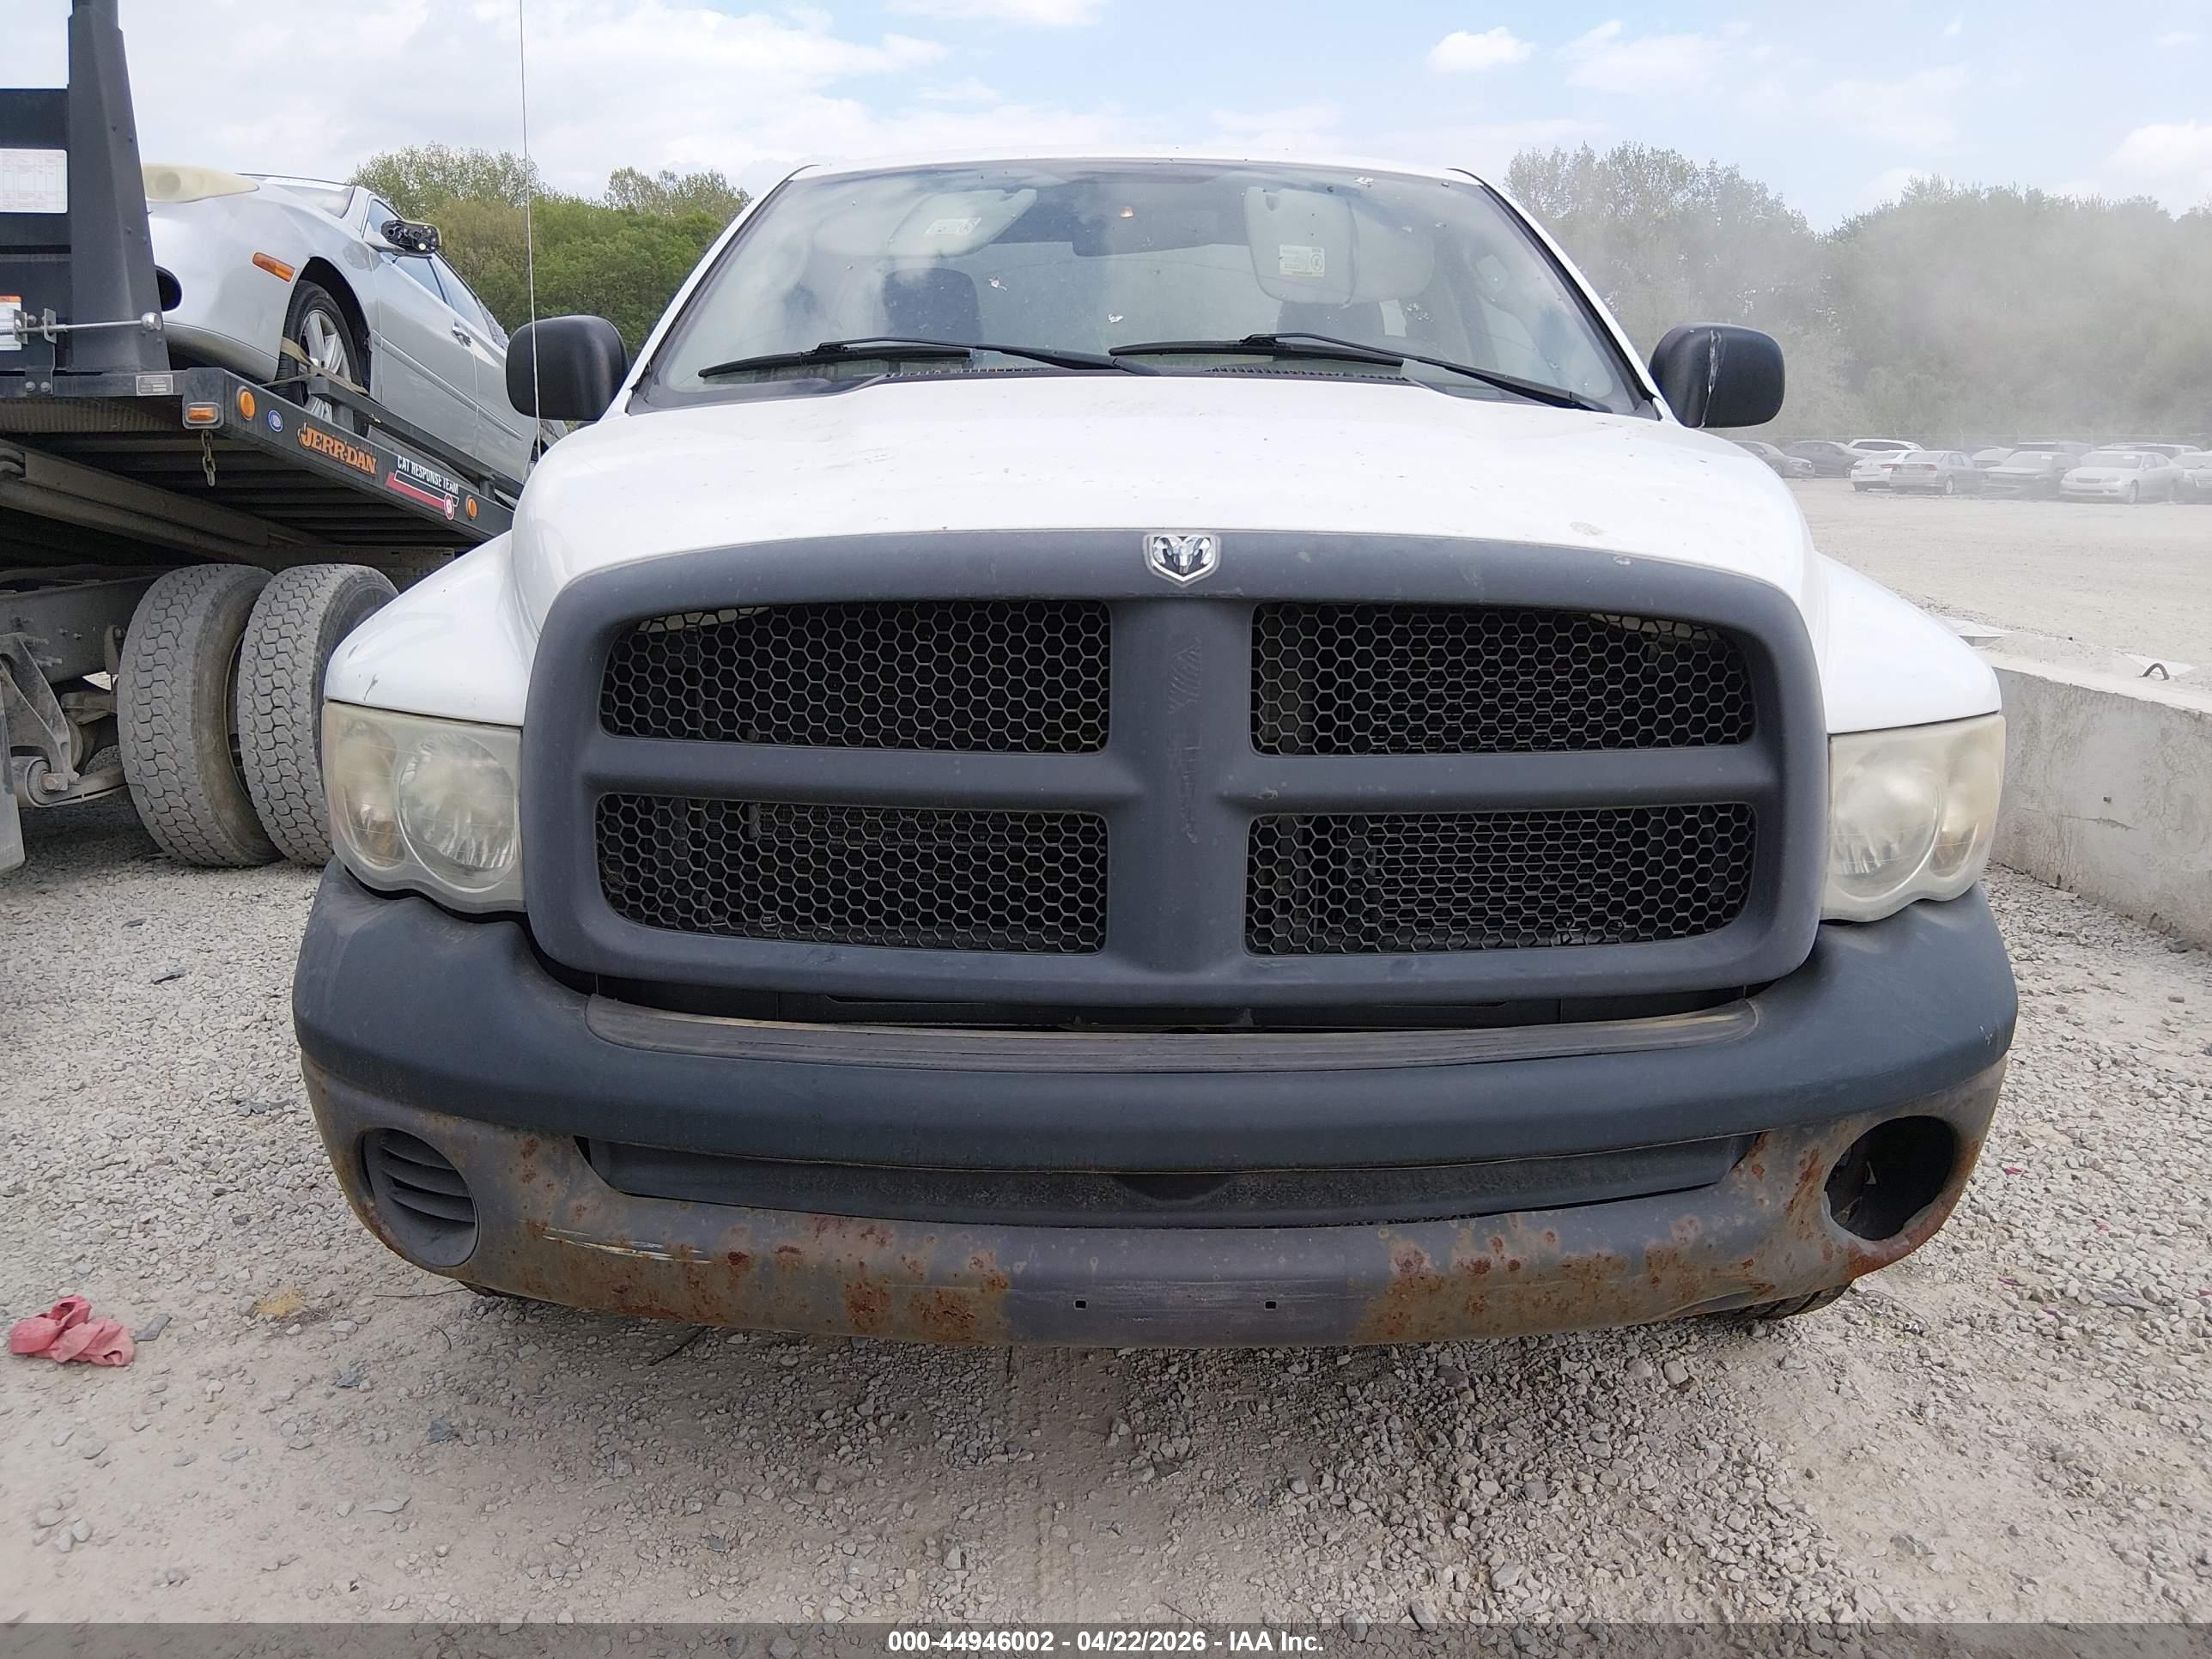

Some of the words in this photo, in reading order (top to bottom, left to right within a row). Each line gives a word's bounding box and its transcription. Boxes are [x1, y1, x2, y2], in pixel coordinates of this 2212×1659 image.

[398, 455, 410, 472] CAT
[411, 461, 442, 488] RESPONSE
[441, 475, 459, 495] TEAM
